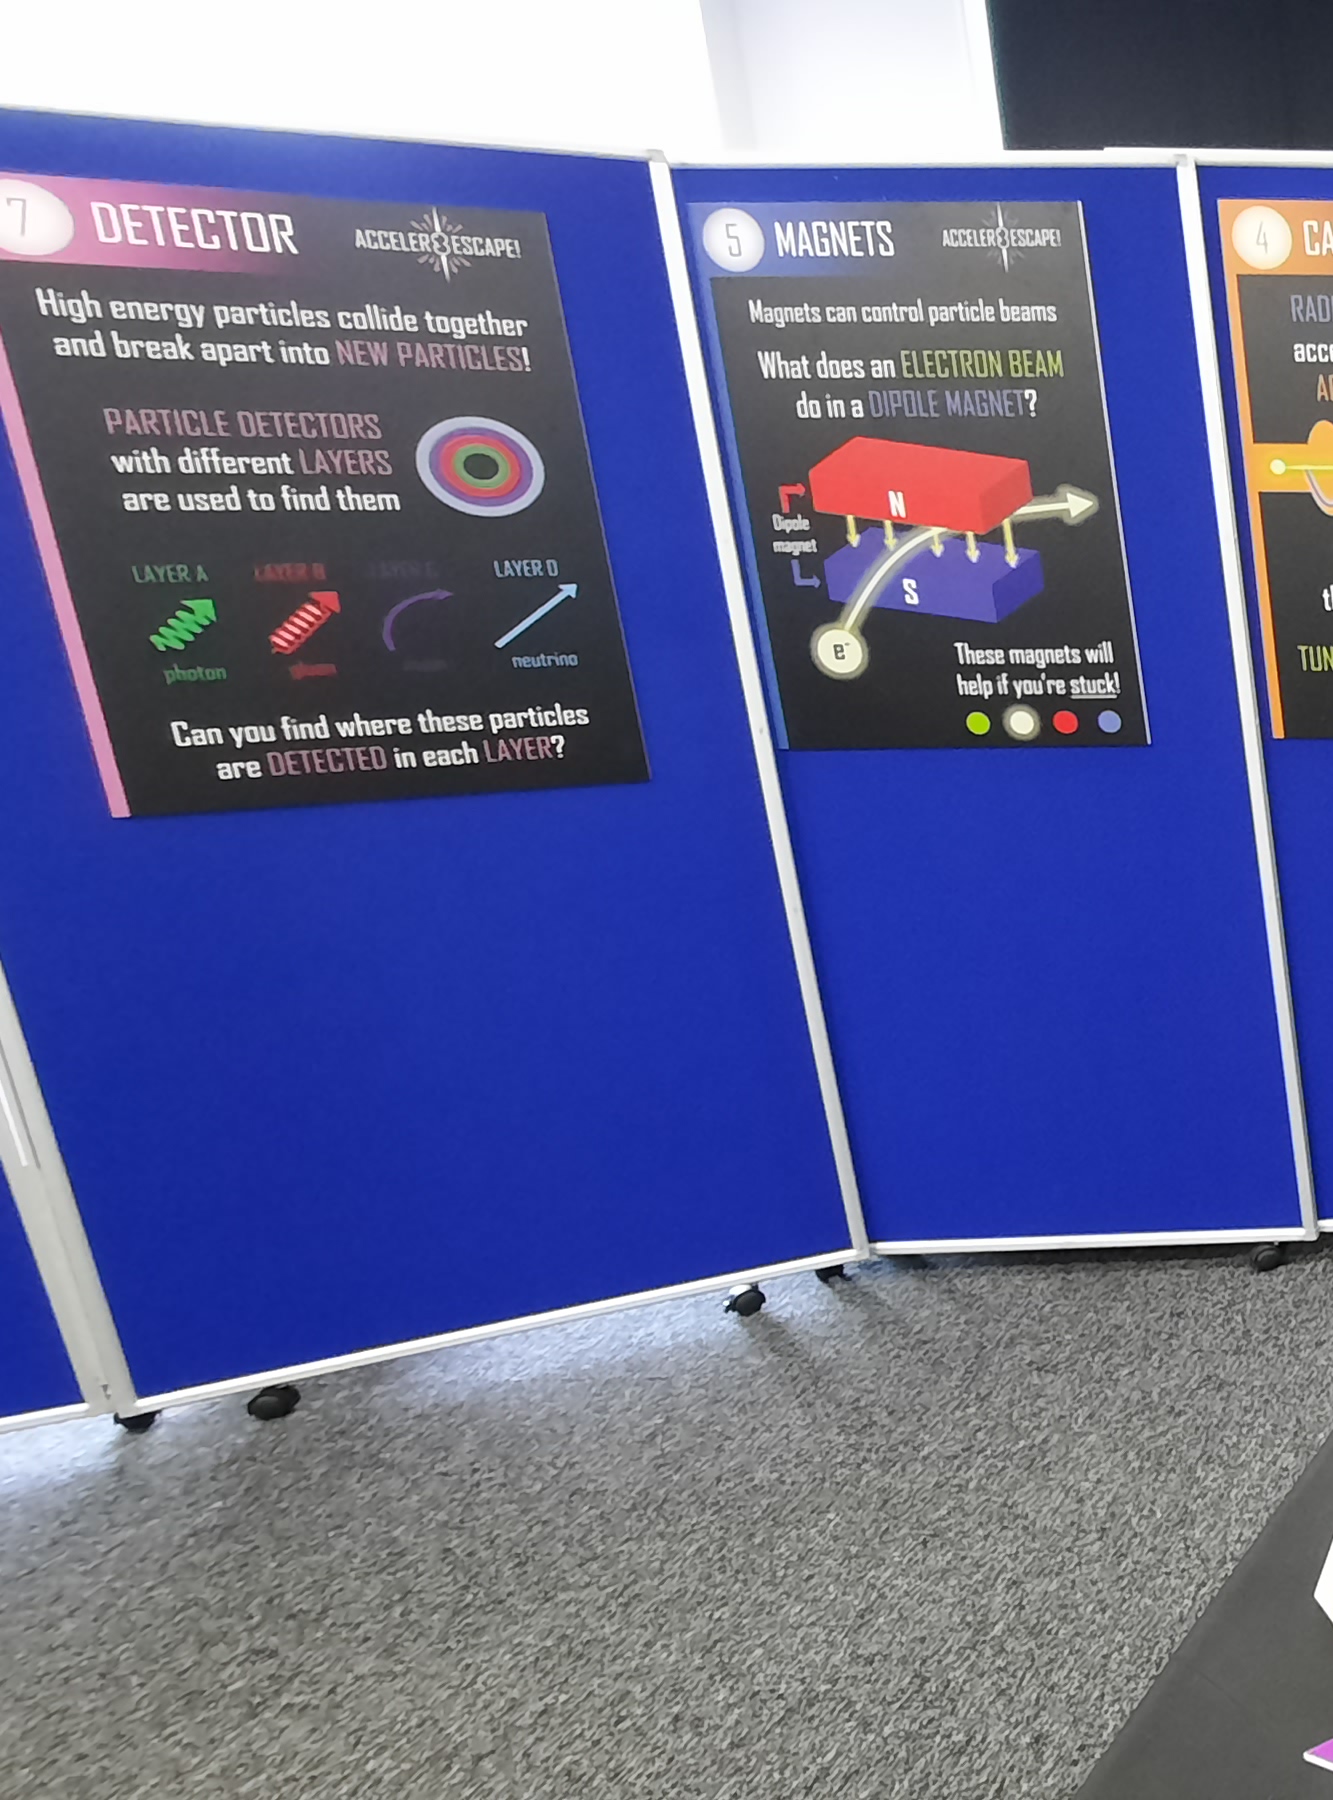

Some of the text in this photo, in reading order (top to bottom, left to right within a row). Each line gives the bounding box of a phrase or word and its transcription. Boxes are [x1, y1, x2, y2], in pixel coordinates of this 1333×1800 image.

[6, 197, 27, 237] 7
[91, 201, 299, 254] DETECTOR
[726, 223, 743, 257] 5
[774, 220, 896, 258] MAGNETS
[1255, 221, 1269, 254] 4
[35, 288, 528, 340] High energy particles collide together
[748, 298, 1058, 329] Magnets can control particle beams
[757, 349, 1064, 380] What does an ELECTRON BEAM
[103, 407, 382, 440] PARTICLE DETECTORS
[110, 447, 393, 476] with different LAYERS
[122, 484, 401, 512] are used to find them
[887, 490, 906, 518] N
[772, 513, 810, 533] Dipole
[773, 536, 817, 556] magnet
[132, 564, 209, 583] LAYER A
[494, 560, 543, 579] LAYER
[902, 578, 920, 605] S
[511, 651, 578, 668] neutrino
[954, 640, 1114, 668] These magnets will
[163, 664, 227, 685] photon
[956, 671, 1121, 699] help if you're stuck!
[171, 703, 590, 749] Can you find where these particles
